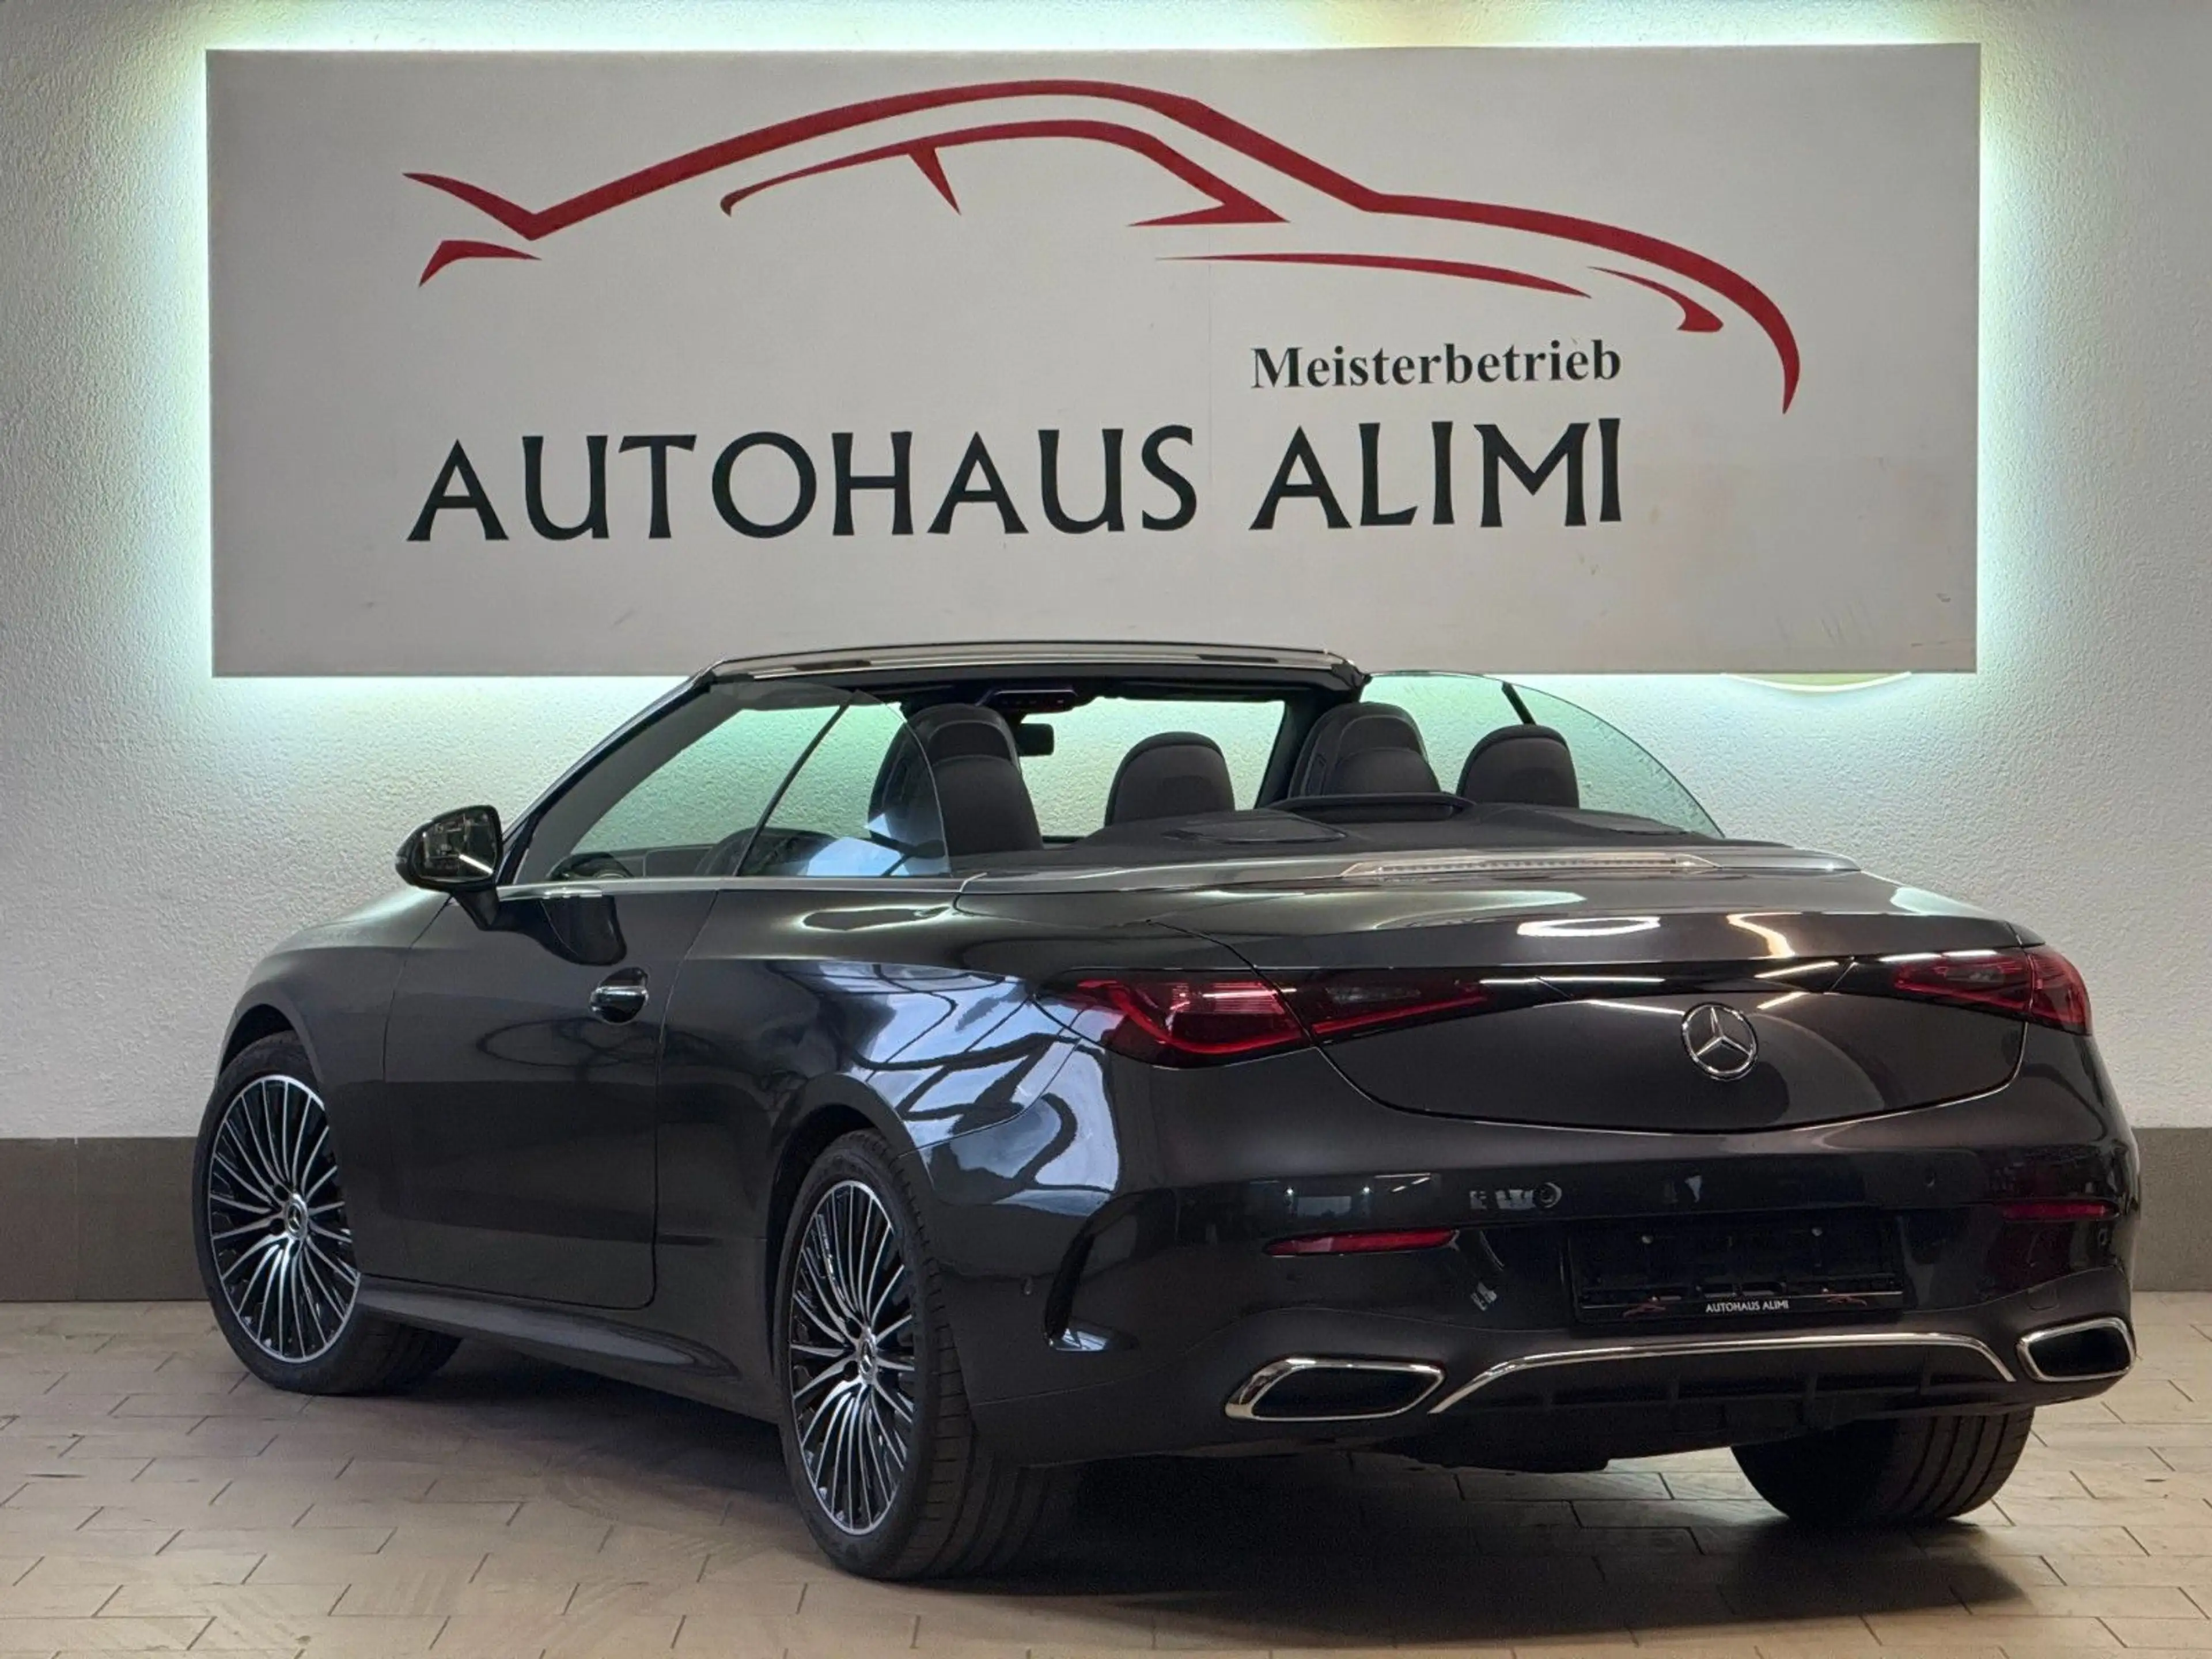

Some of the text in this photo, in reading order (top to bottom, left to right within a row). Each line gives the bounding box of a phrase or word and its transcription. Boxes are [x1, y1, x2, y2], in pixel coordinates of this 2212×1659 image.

[1252, 339, 1622, 389] Meisterbetrieb
[406, 418, 1622, 543] AUTOHAUS ALIMI
[1706, 1300, 1789, 1313] AUTOHAUS ALIMI
